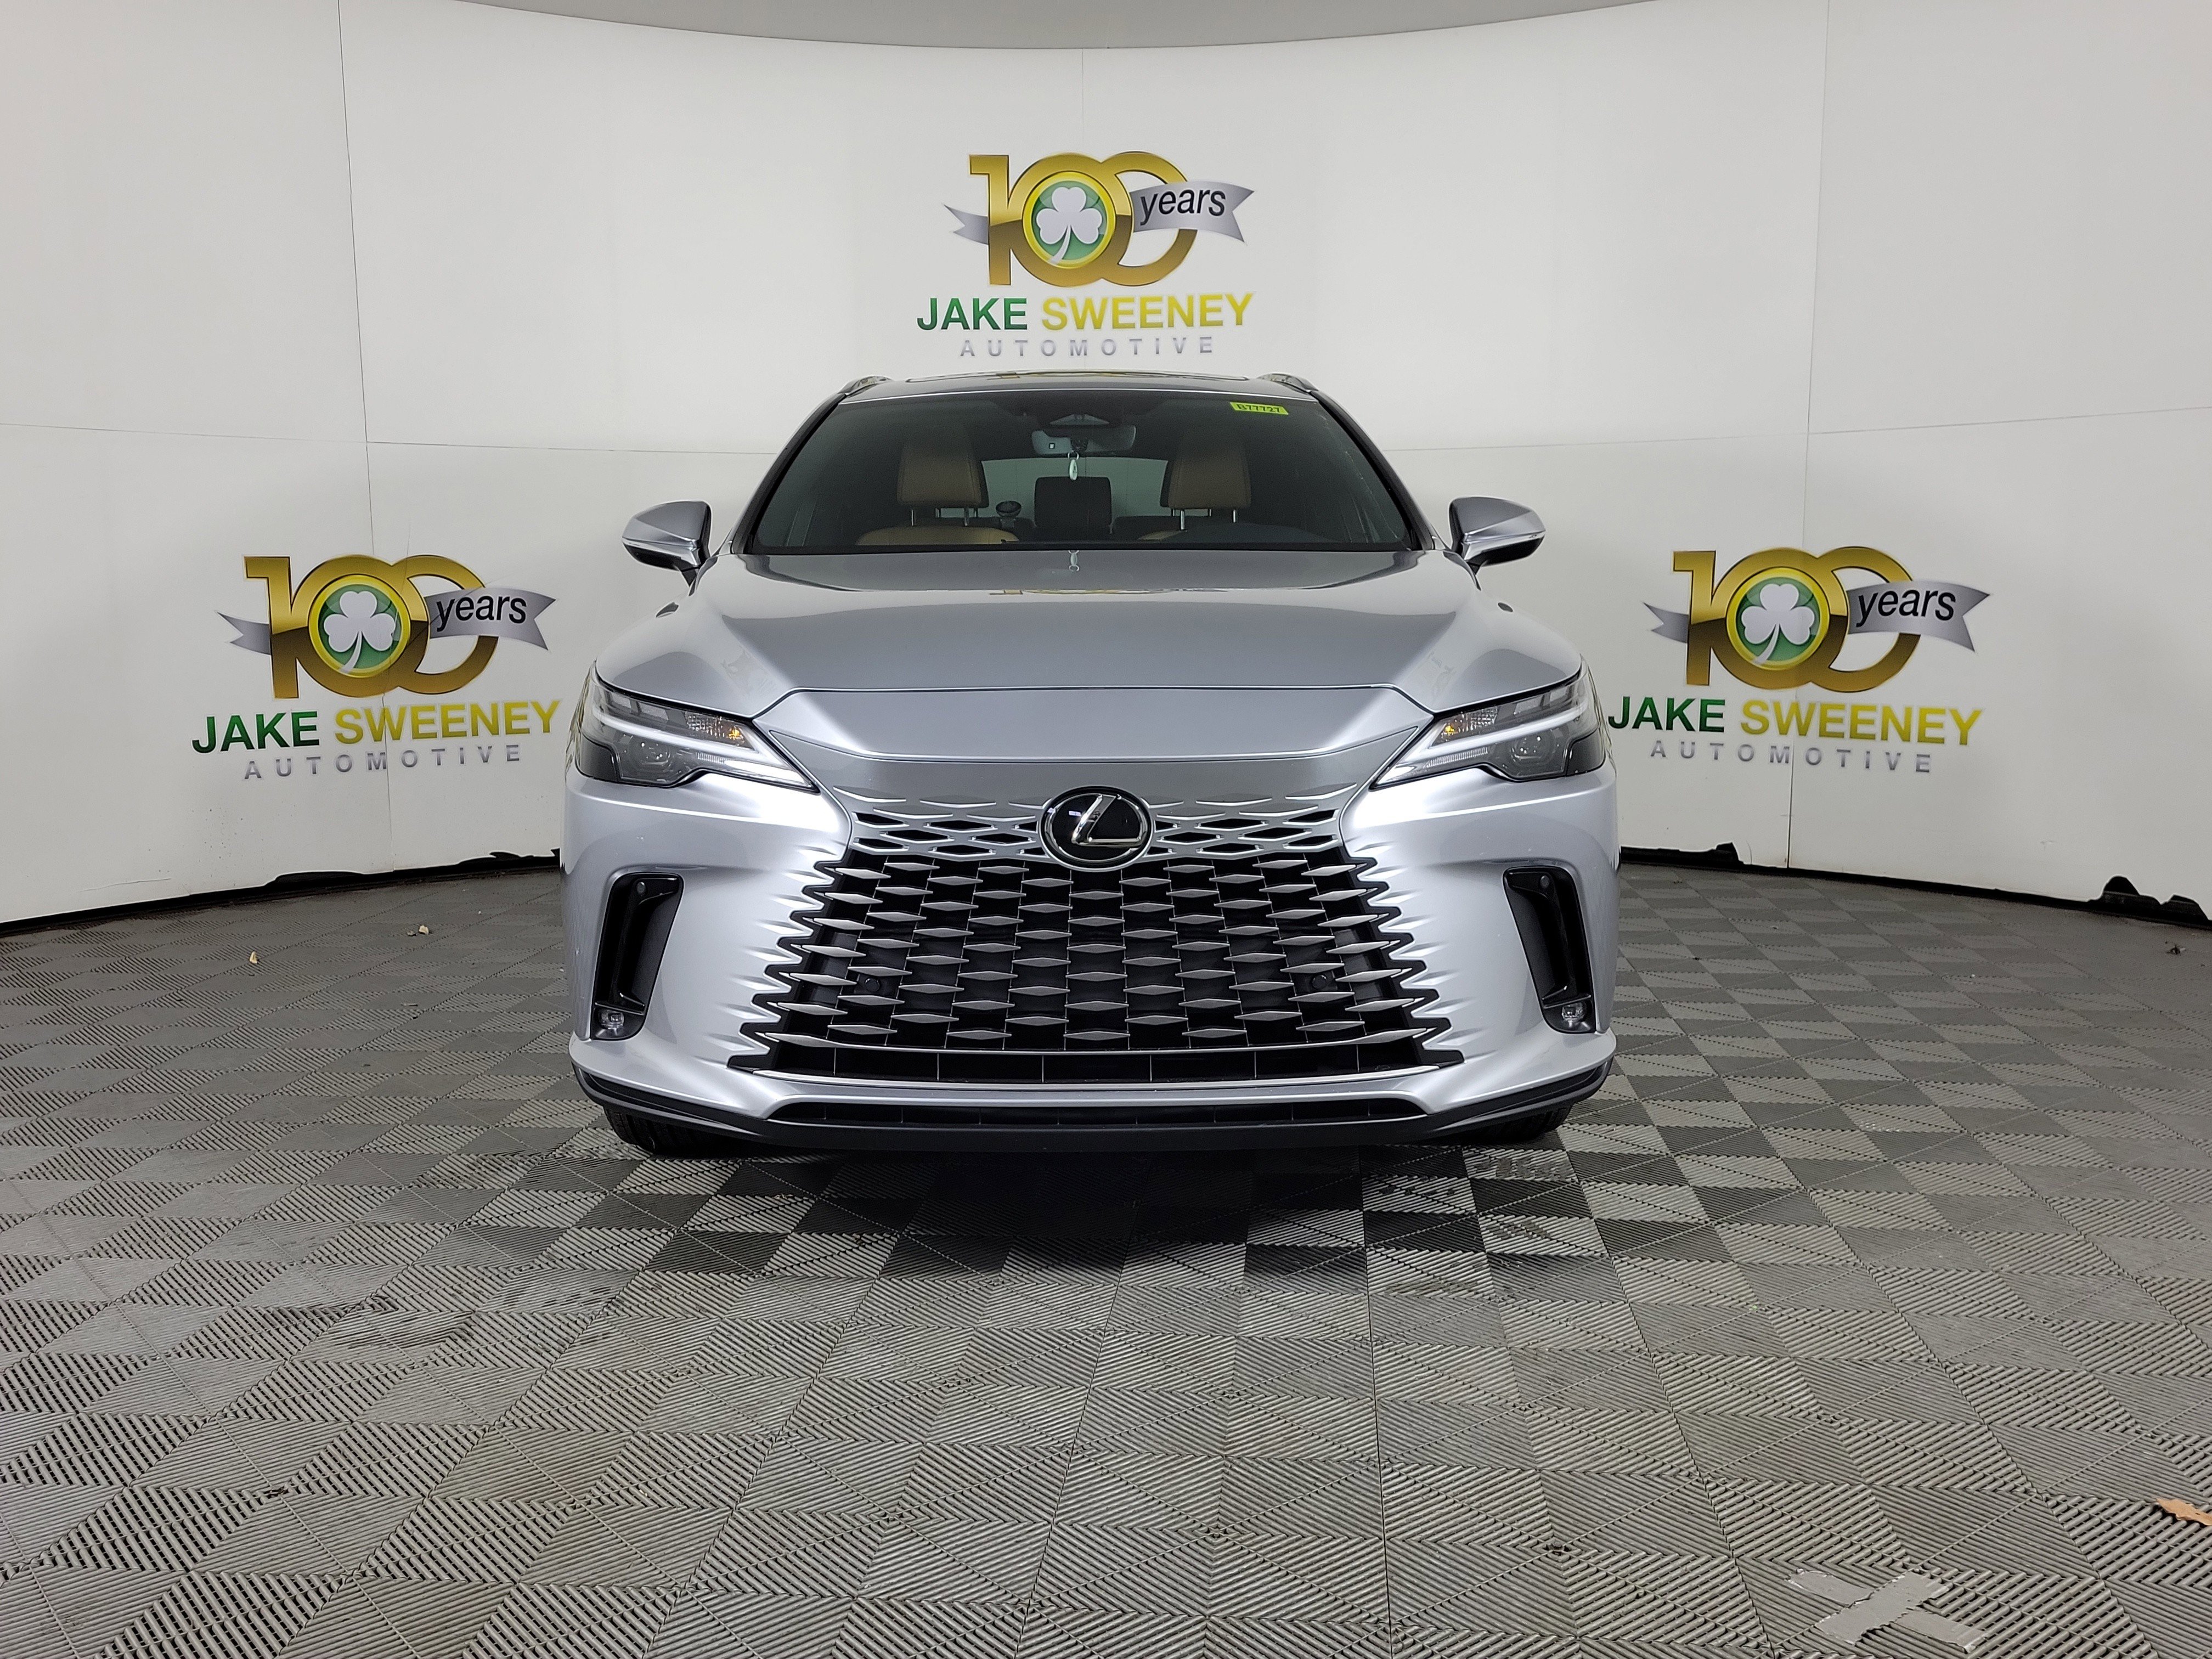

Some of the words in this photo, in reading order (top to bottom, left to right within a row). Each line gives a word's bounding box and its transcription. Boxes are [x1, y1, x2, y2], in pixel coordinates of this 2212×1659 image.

[969, 151, 1199, 287] 100
[1140, 187, 1226, 226] years
[917, 297, 1028, 330] JAKE
[1041, 292, 1255, 330] SWEENEY
[960, 336, 1213, 357] AUTOMOTIVE
[244, 554, 499, 698] 100
[436, 594, 527, 632] years
[1672, 546, 1922, 693] 100
[1855, 588, 1956, 627] years
[192, 710, 320, 753] JAKE
[334, 700, 561, 745] SWEENEY
[1608, 696, 1726, 733] JAKE
[1740, 699, 1983, 746] SWEENEY
[244, 744, 520, 780] AUTOMOTIVE
[1650, 740, 1931, 773] AUTOMOTIVE
